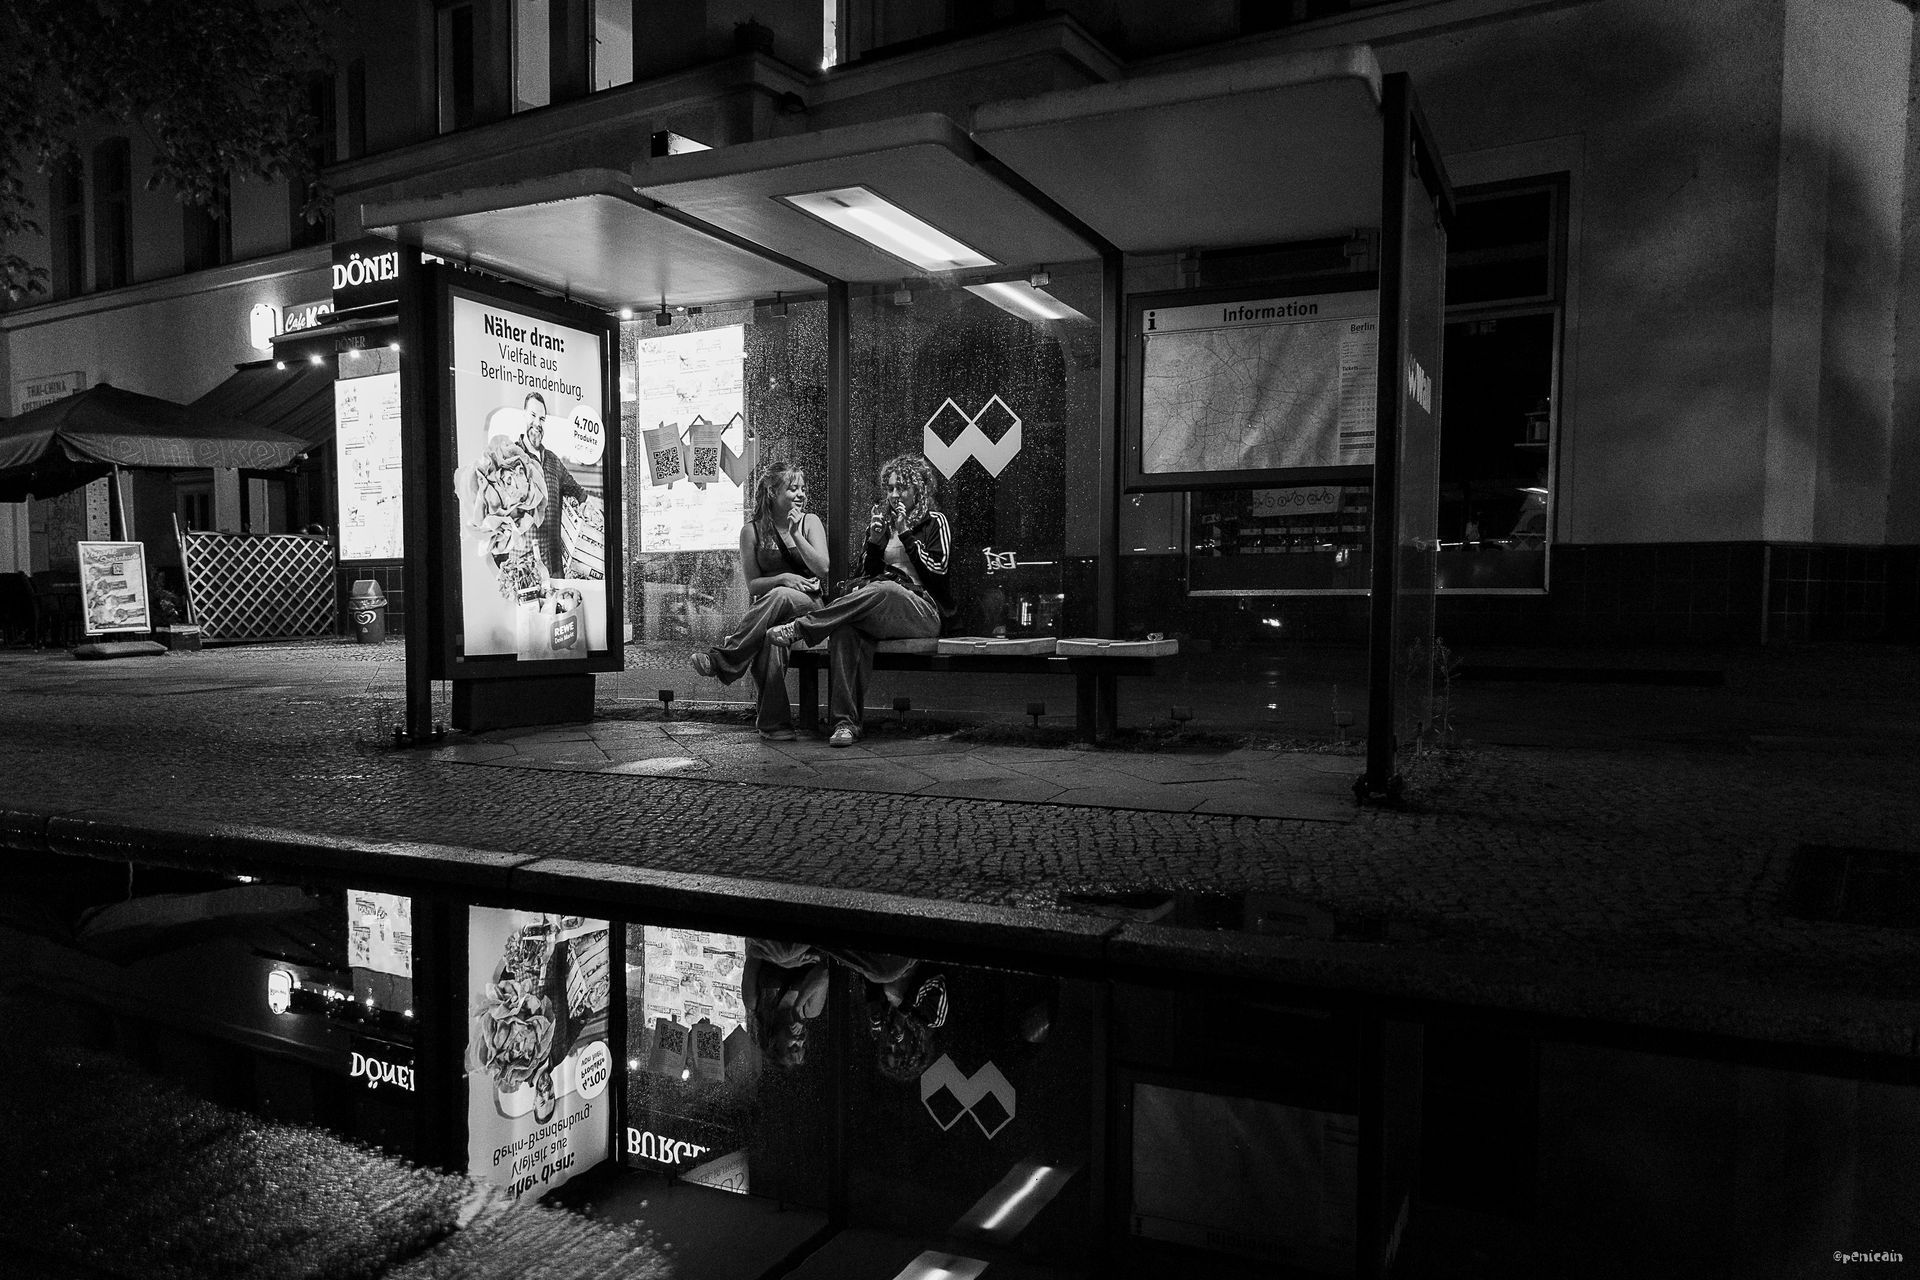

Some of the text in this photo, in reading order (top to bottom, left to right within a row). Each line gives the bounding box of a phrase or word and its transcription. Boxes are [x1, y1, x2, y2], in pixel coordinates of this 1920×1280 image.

[1223, 301, 1318, 322] Information
[285, 312, 307, 332] Cafe
[1350, 322, 1376, 333] Berlin
[484, 313, 565, 353] Näher dran:
[498, 342, 558, 372] Vielfalt aus
[480, 360, 584, 402] Berlin-Brandenburg.
[574, 415, 600, 435] 4.700
[573, 430, 598, 446] Produkte
[554, 621, 575, 637] REWE
